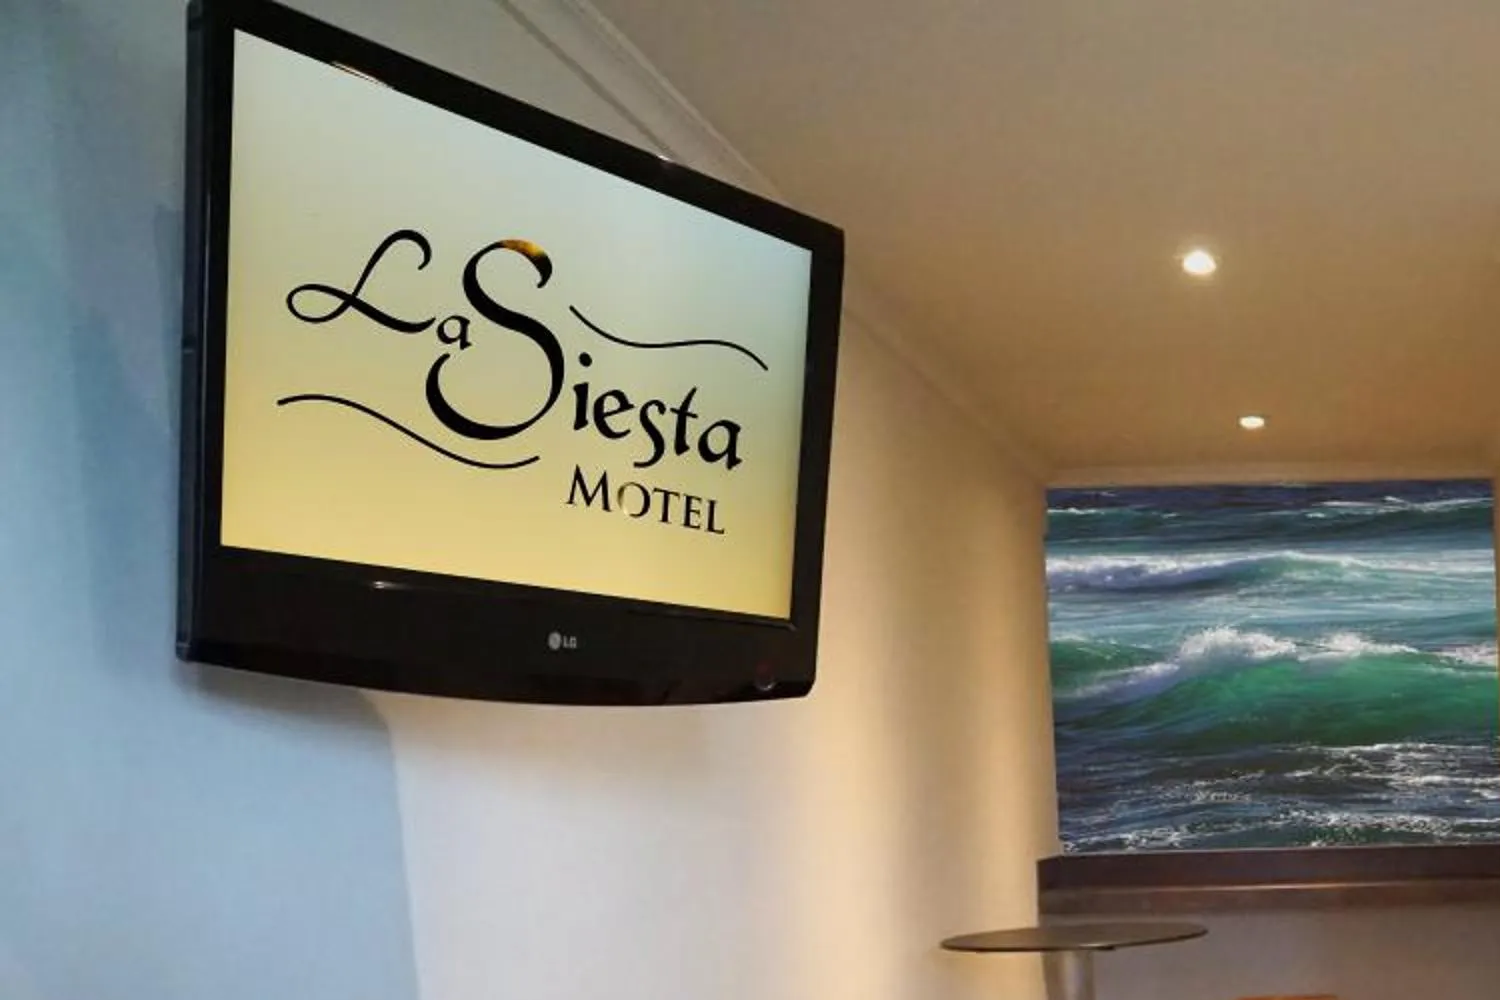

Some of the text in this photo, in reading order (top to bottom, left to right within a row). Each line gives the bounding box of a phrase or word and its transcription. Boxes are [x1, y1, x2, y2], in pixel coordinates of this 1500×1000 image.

[286, 229, 743, 471] La Siesta
[566, 463, 726, 535] MOTEL
